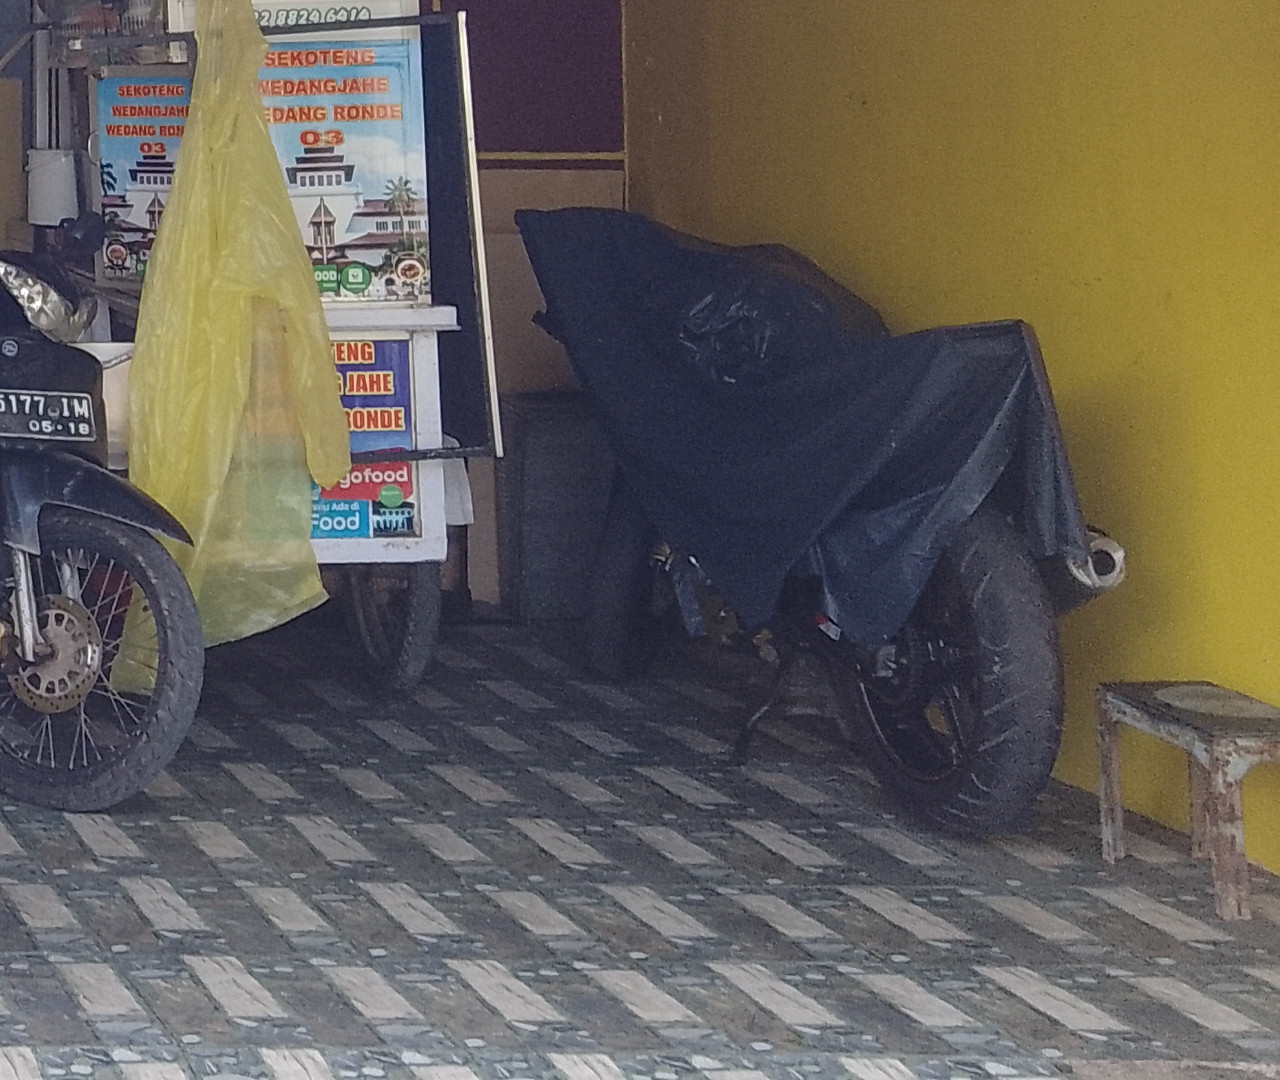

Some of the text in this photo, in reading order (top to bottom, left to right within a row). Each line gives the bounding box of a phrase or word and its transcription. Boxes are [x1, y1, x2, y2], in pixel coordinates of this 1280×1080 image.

[265, 50, 375, 67] SEKOTENG
[118, 85, 185, 97] SEKOTENG
[264, 104, 402, 123] EDANG RONDE
[105, 125, 184, 137] WEDANG RON
[299, 129, 344, 146] 03
[140, 142, 166, 154] 03
[314, 271, 337, 281] OOD
[347, 372, 393, 394] JAHE
